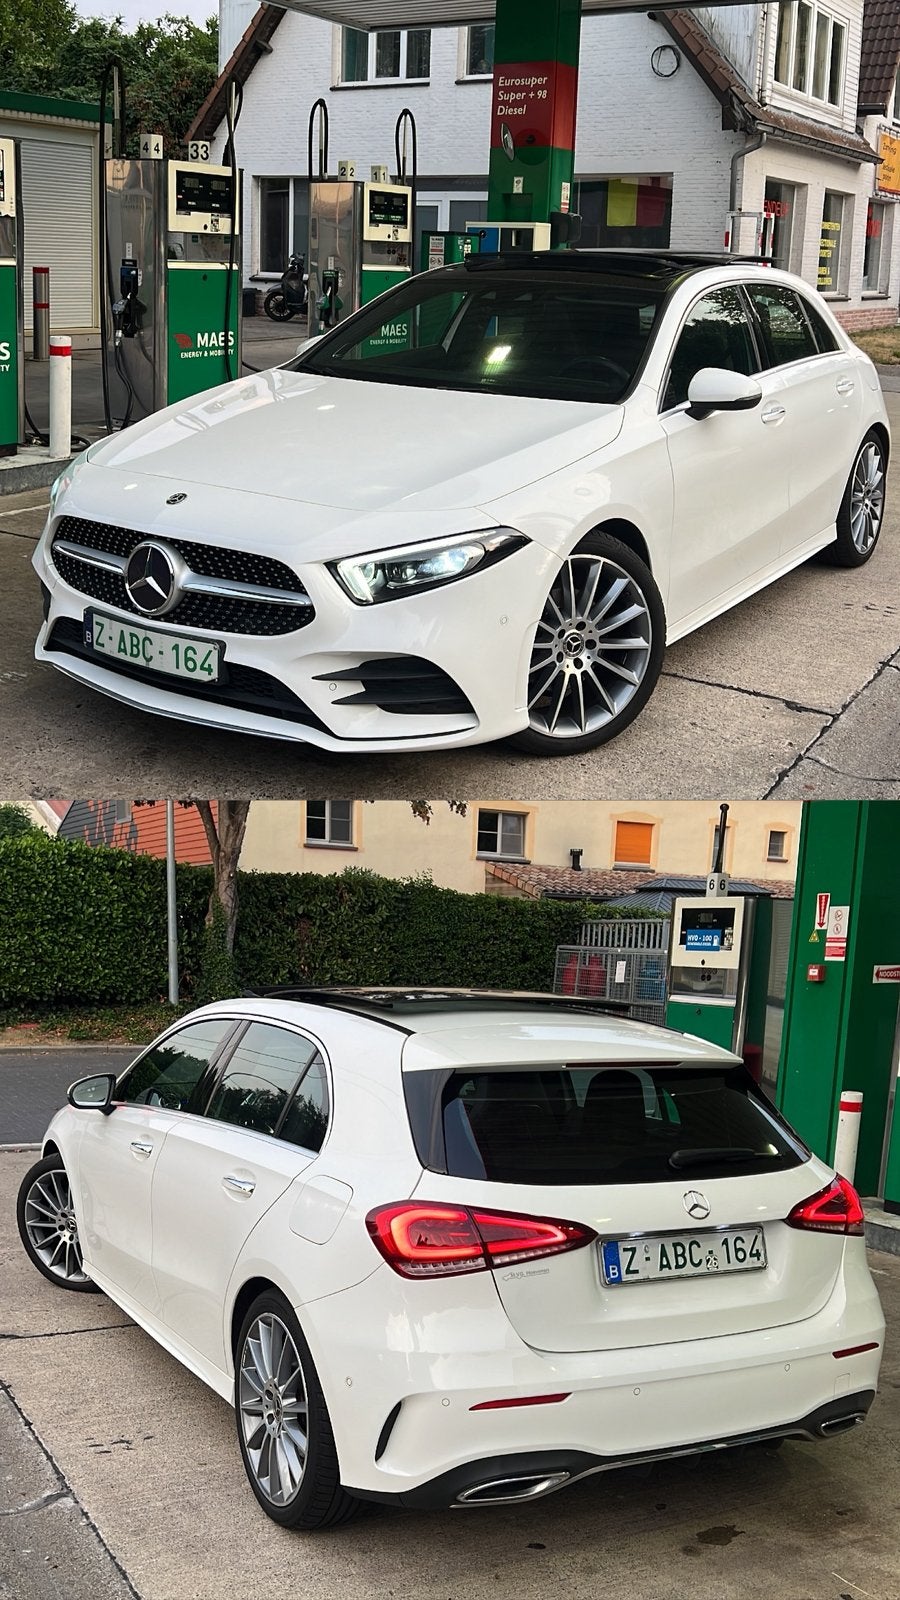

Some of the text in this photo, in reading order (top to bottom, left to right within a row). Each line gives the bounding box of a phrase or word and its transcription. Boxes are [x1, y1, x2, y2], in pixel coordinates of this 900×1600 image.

[498, 76, 548, 88] Eurosuper
[498, 89, 548, 103] Super + 98
[497, 104, 527, 116] Diesel
[381, 323, 408, 337] MAES
[197, 331, 235, 348] MAES
[180, 351, 203, 359] ENERGY
[85, 630, 92, 643] B
[702, 934, 713, 942] 100
[609, 1265, 619, 1279] B
